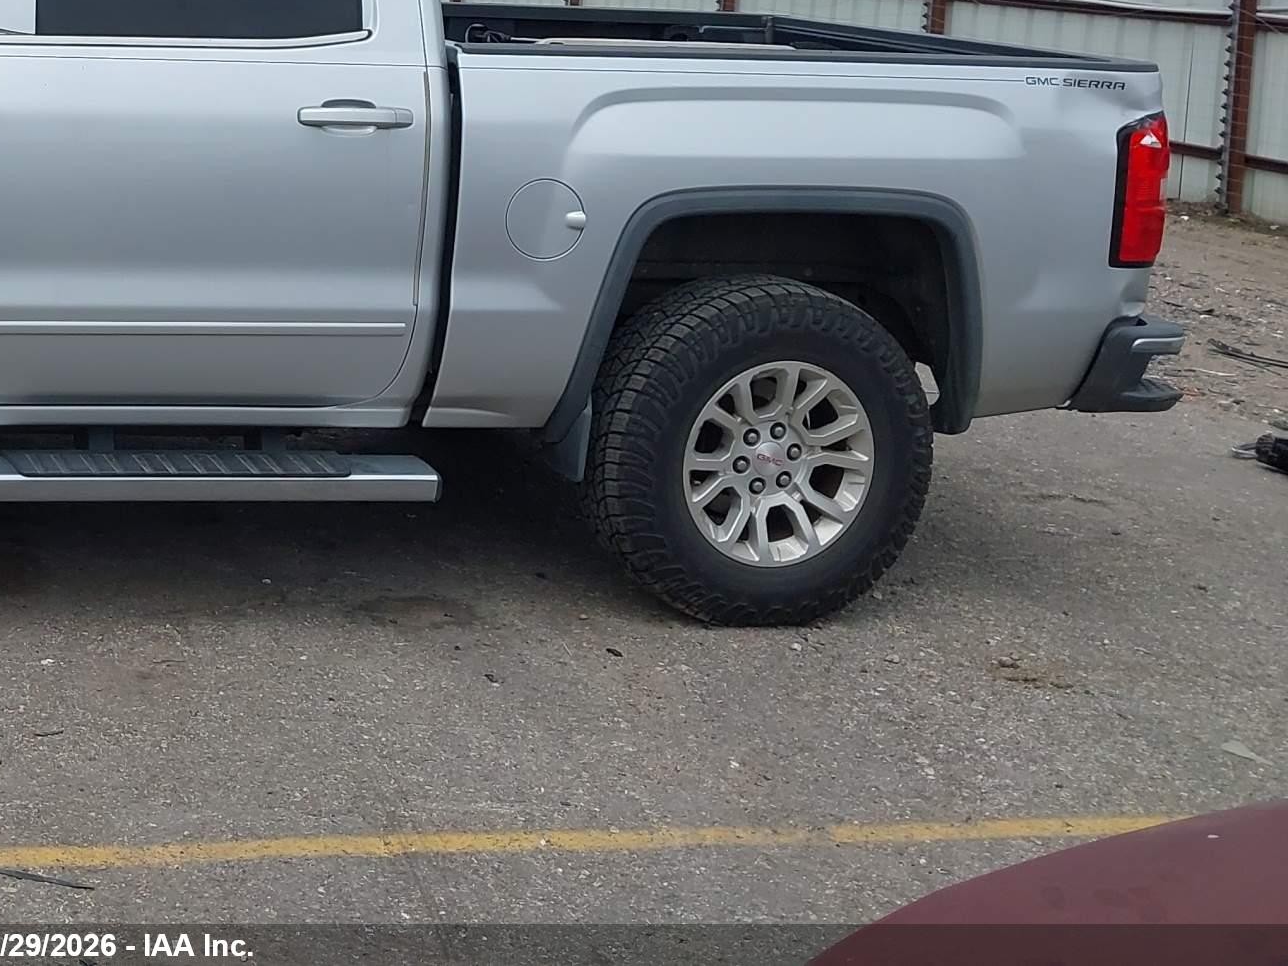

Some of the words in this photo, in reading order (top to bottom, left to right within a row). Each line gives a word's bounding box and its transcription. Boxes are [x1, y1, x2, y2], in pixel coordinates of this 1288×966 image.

[1025, 76, 1060, 86] GMC
[1062, 78, 1126, 91] SIERRA
[756, 453, 783, 467] GMC
